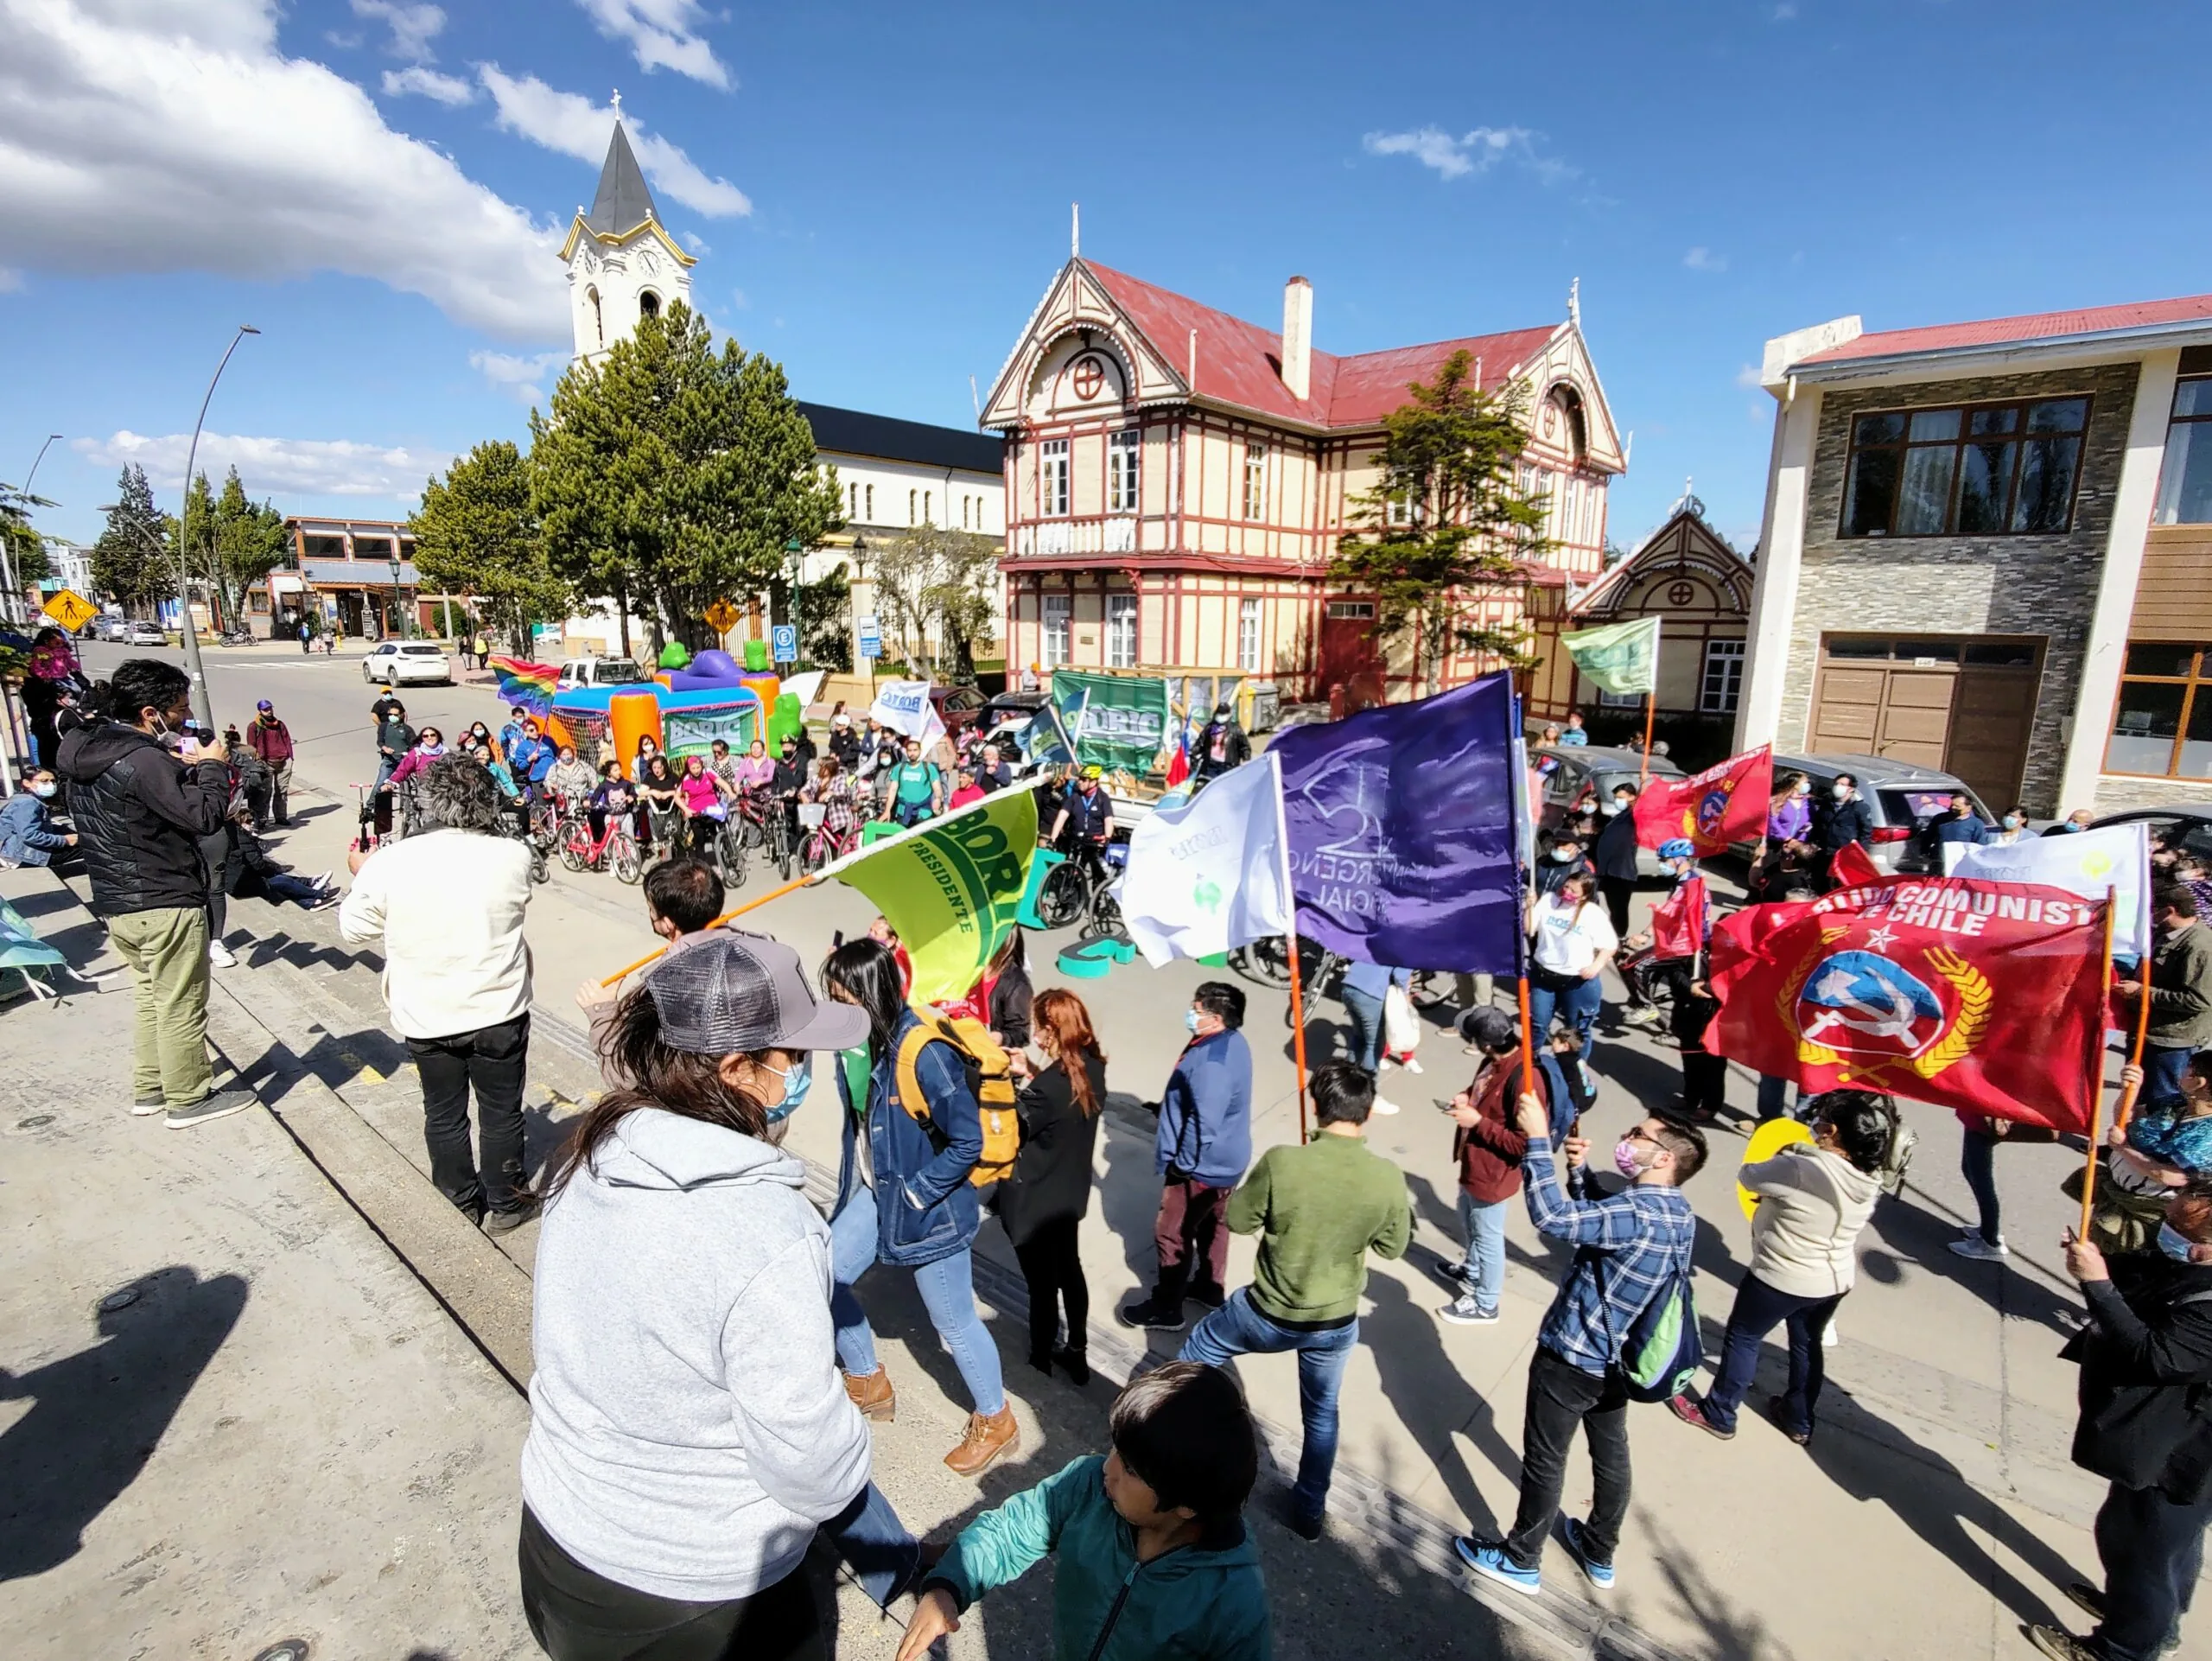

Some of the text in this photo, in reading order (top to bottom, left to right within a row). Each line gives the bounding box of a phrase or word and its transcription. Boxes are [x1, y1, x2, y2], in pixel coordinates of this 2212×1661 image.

[671, 718, 741, 739] BORIC
[908, 840, 974, 934] PRESIDENTE
[1897, 885, 2093, 926] COMUNIST
[1885, 902, 1990, 937] CHILE
